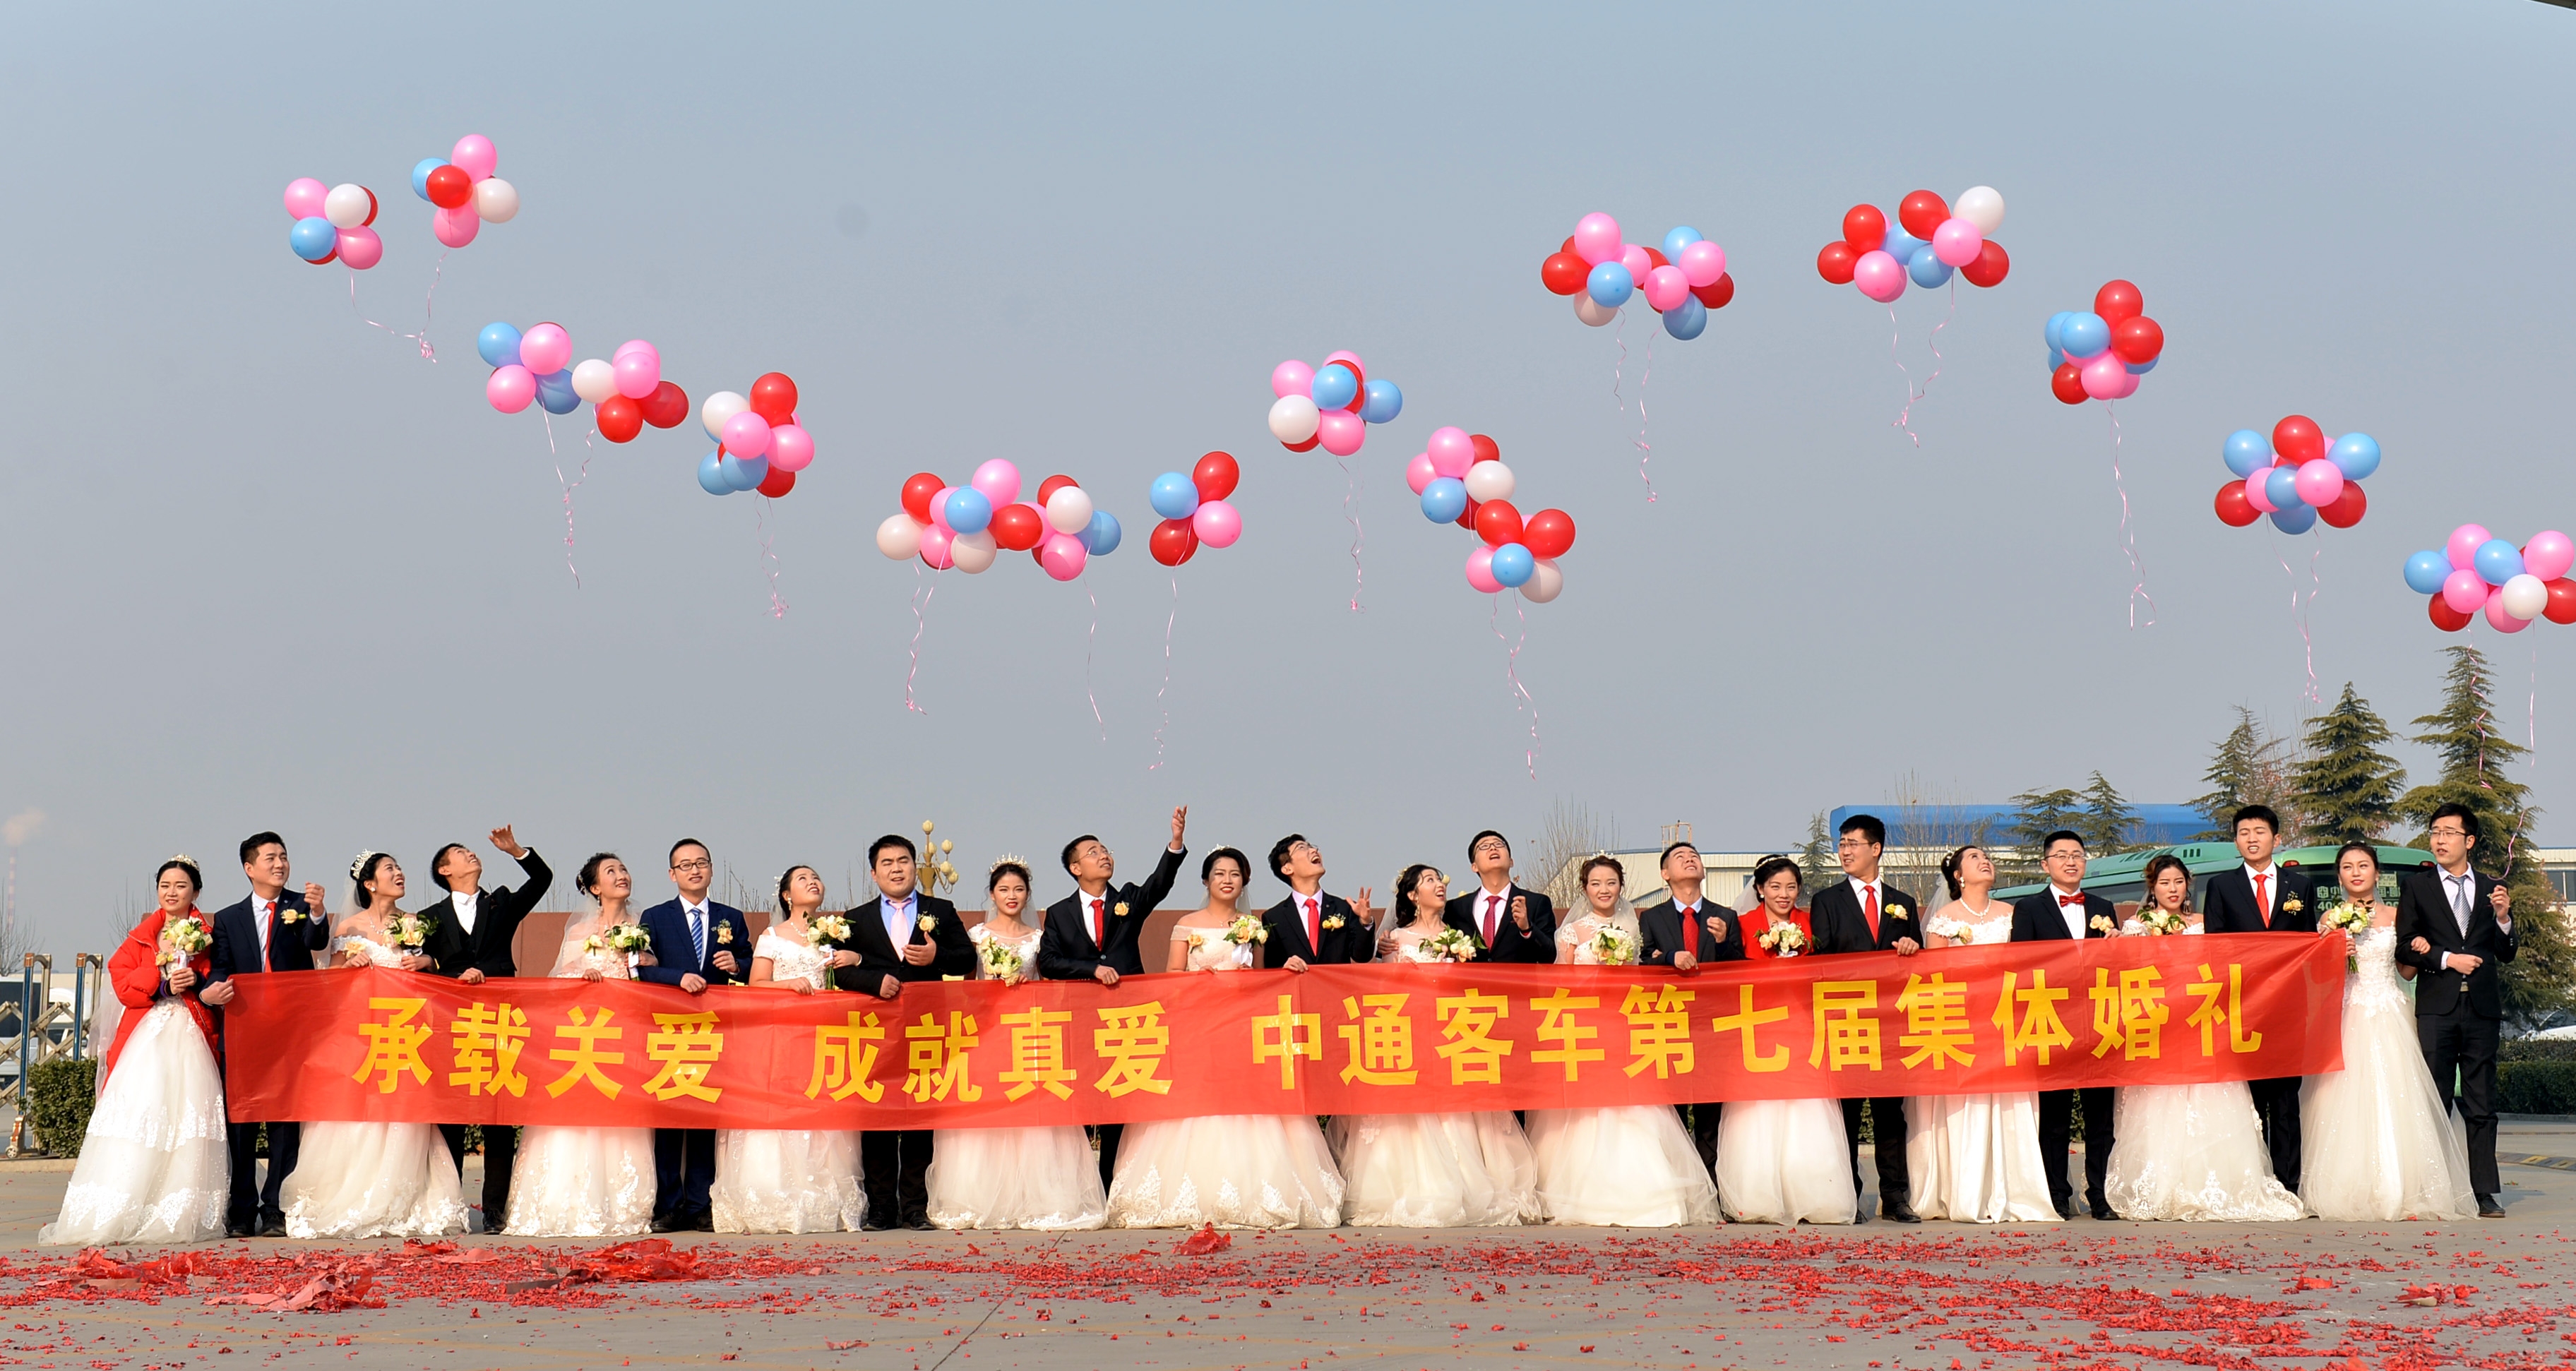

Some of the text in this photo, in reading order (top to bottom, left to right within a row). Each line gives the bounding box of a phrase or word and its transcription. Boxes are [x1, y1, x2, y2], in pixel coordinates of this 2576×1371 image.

[352, 964, 2262, 1103] 承载关爱 成就真爱 中通客车第七届集体婚礼
